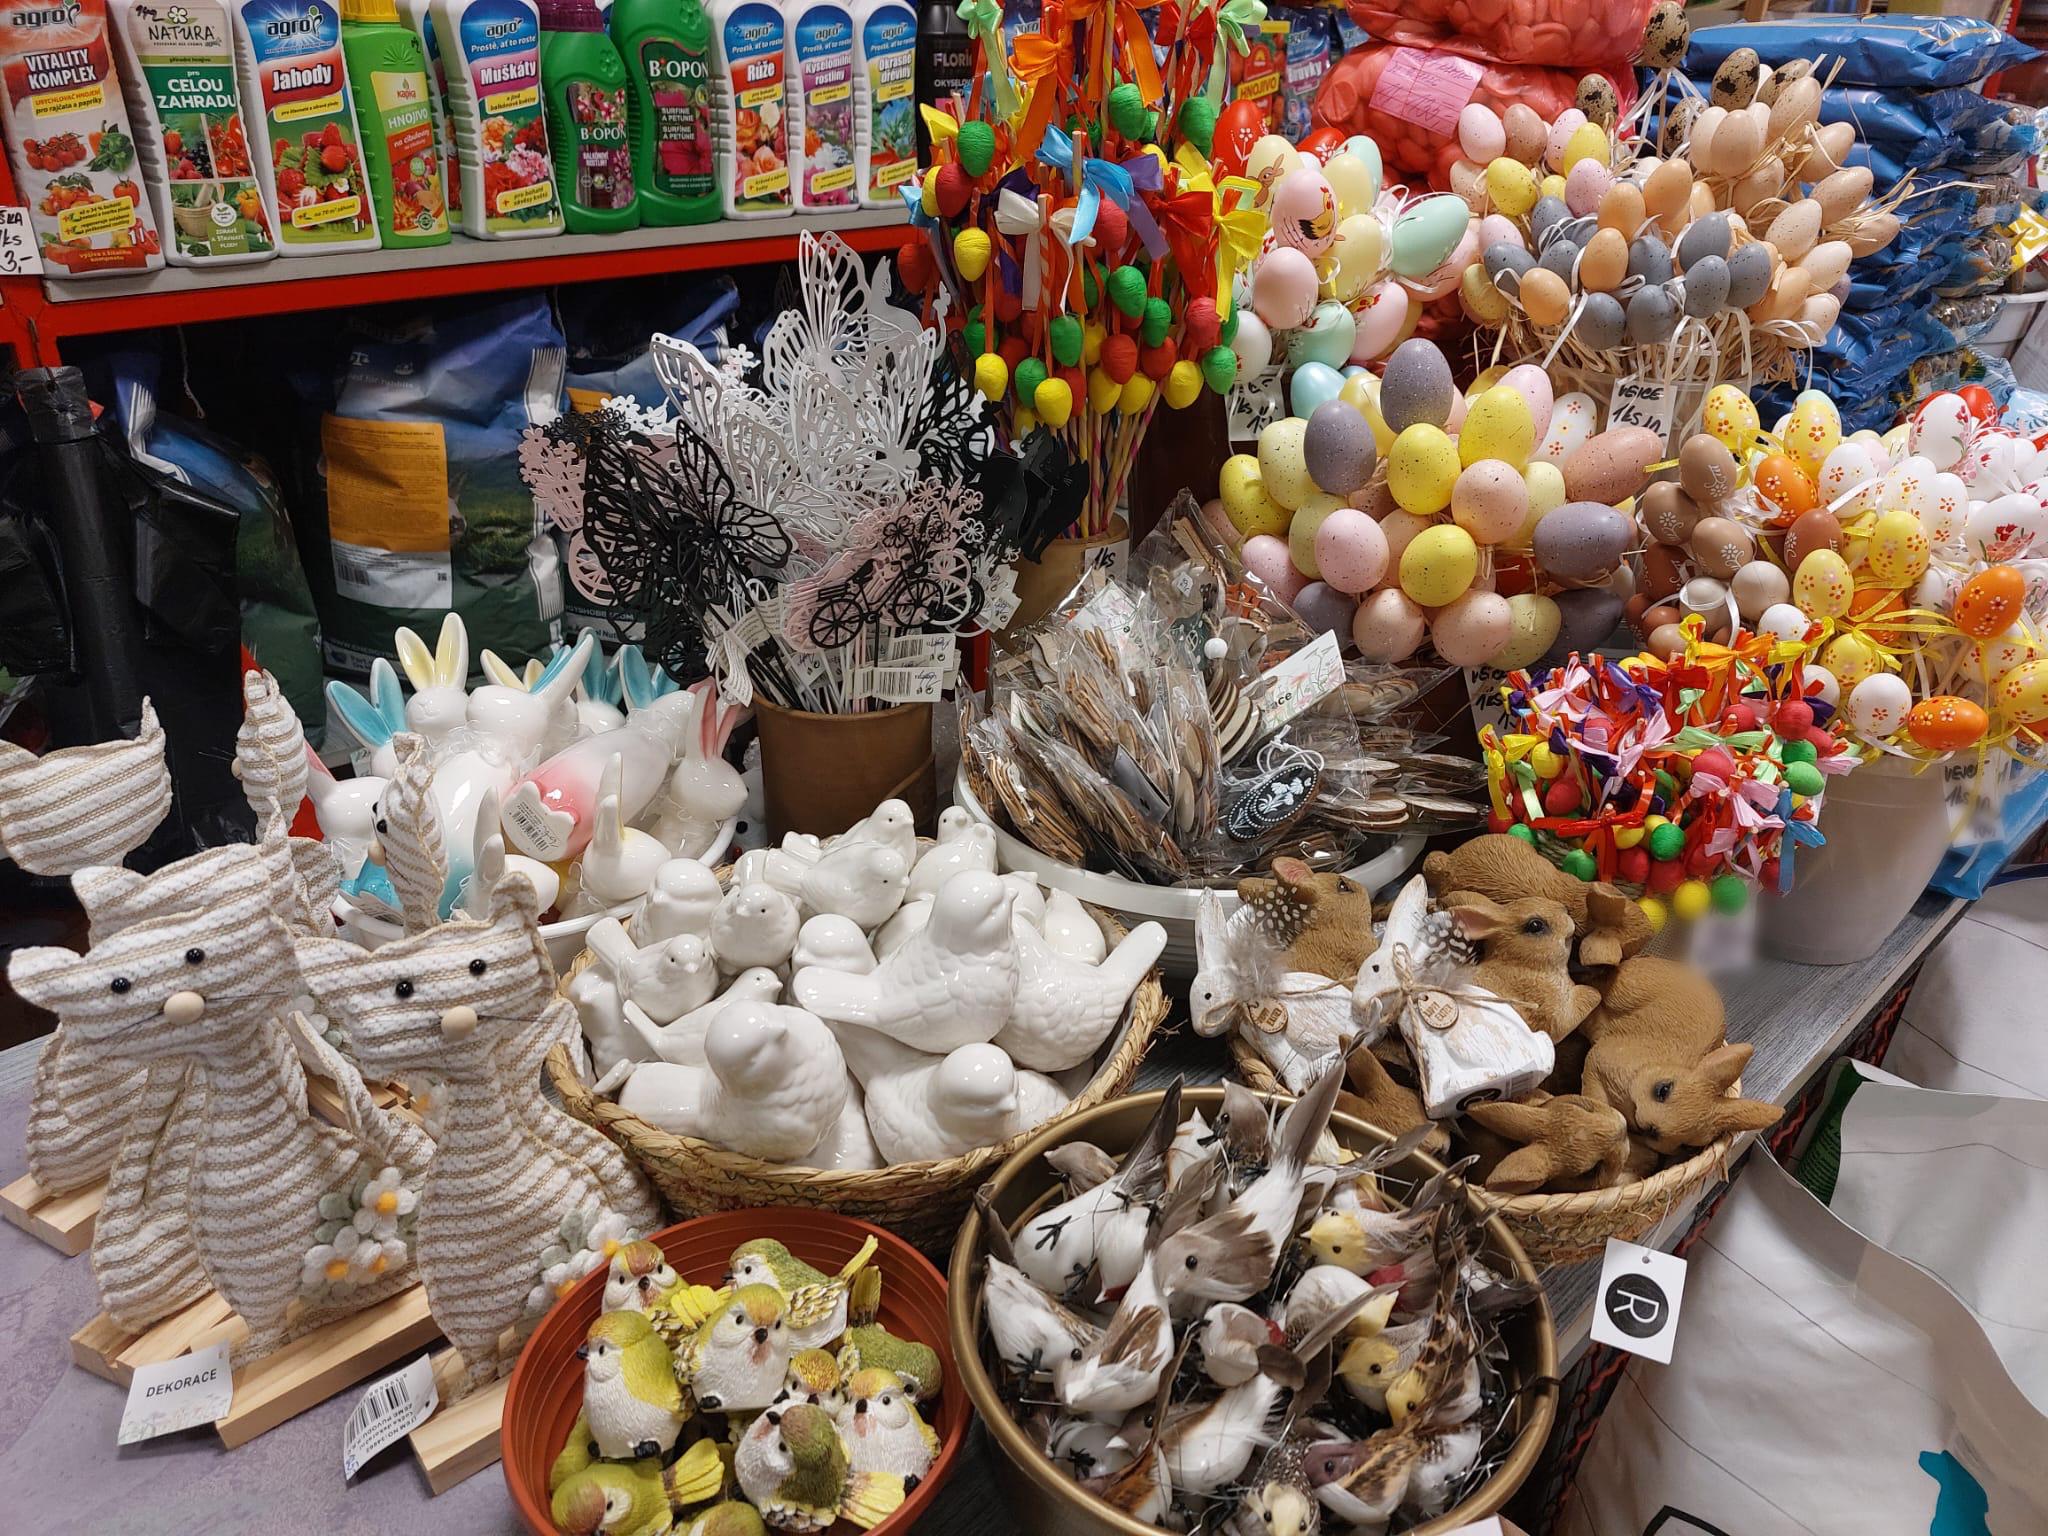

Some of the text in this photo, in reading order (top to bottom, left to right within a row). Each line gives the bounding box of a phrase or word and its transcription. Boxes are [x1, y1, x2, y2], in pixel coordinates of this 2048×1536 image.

[12, 8, 66, 29] agro
[266, 18, 311, 39] agro
[148, 25, 215, 41] NATURA
[486, 22, 517, 38] agro
[25, 48, 89, 72] VITALITY
[747, 60, 775, 81] Růže
[28, 65, 97, 90] KOMPLEX
[272, 63, 332, 91] Jahody
[480, 61, 536, 85] Muškáty
[815, 69, 845, 85] rostliny
[880, 66, 911, 83] dřeviny
[168, 79, 223, 92] CELOU
[1239, 76, 1277, 98] HNOJIVO
[36, 107, 48, 115] pro
[49, 101, 72, 112] rajčata
[78, 97, 103, 109] papriky
[157, 94, 237, 109] ZAHRADU
[388, 108, 428, 129] HNOJIVO
[146, 1368, 217, 1397] DEKORACE
